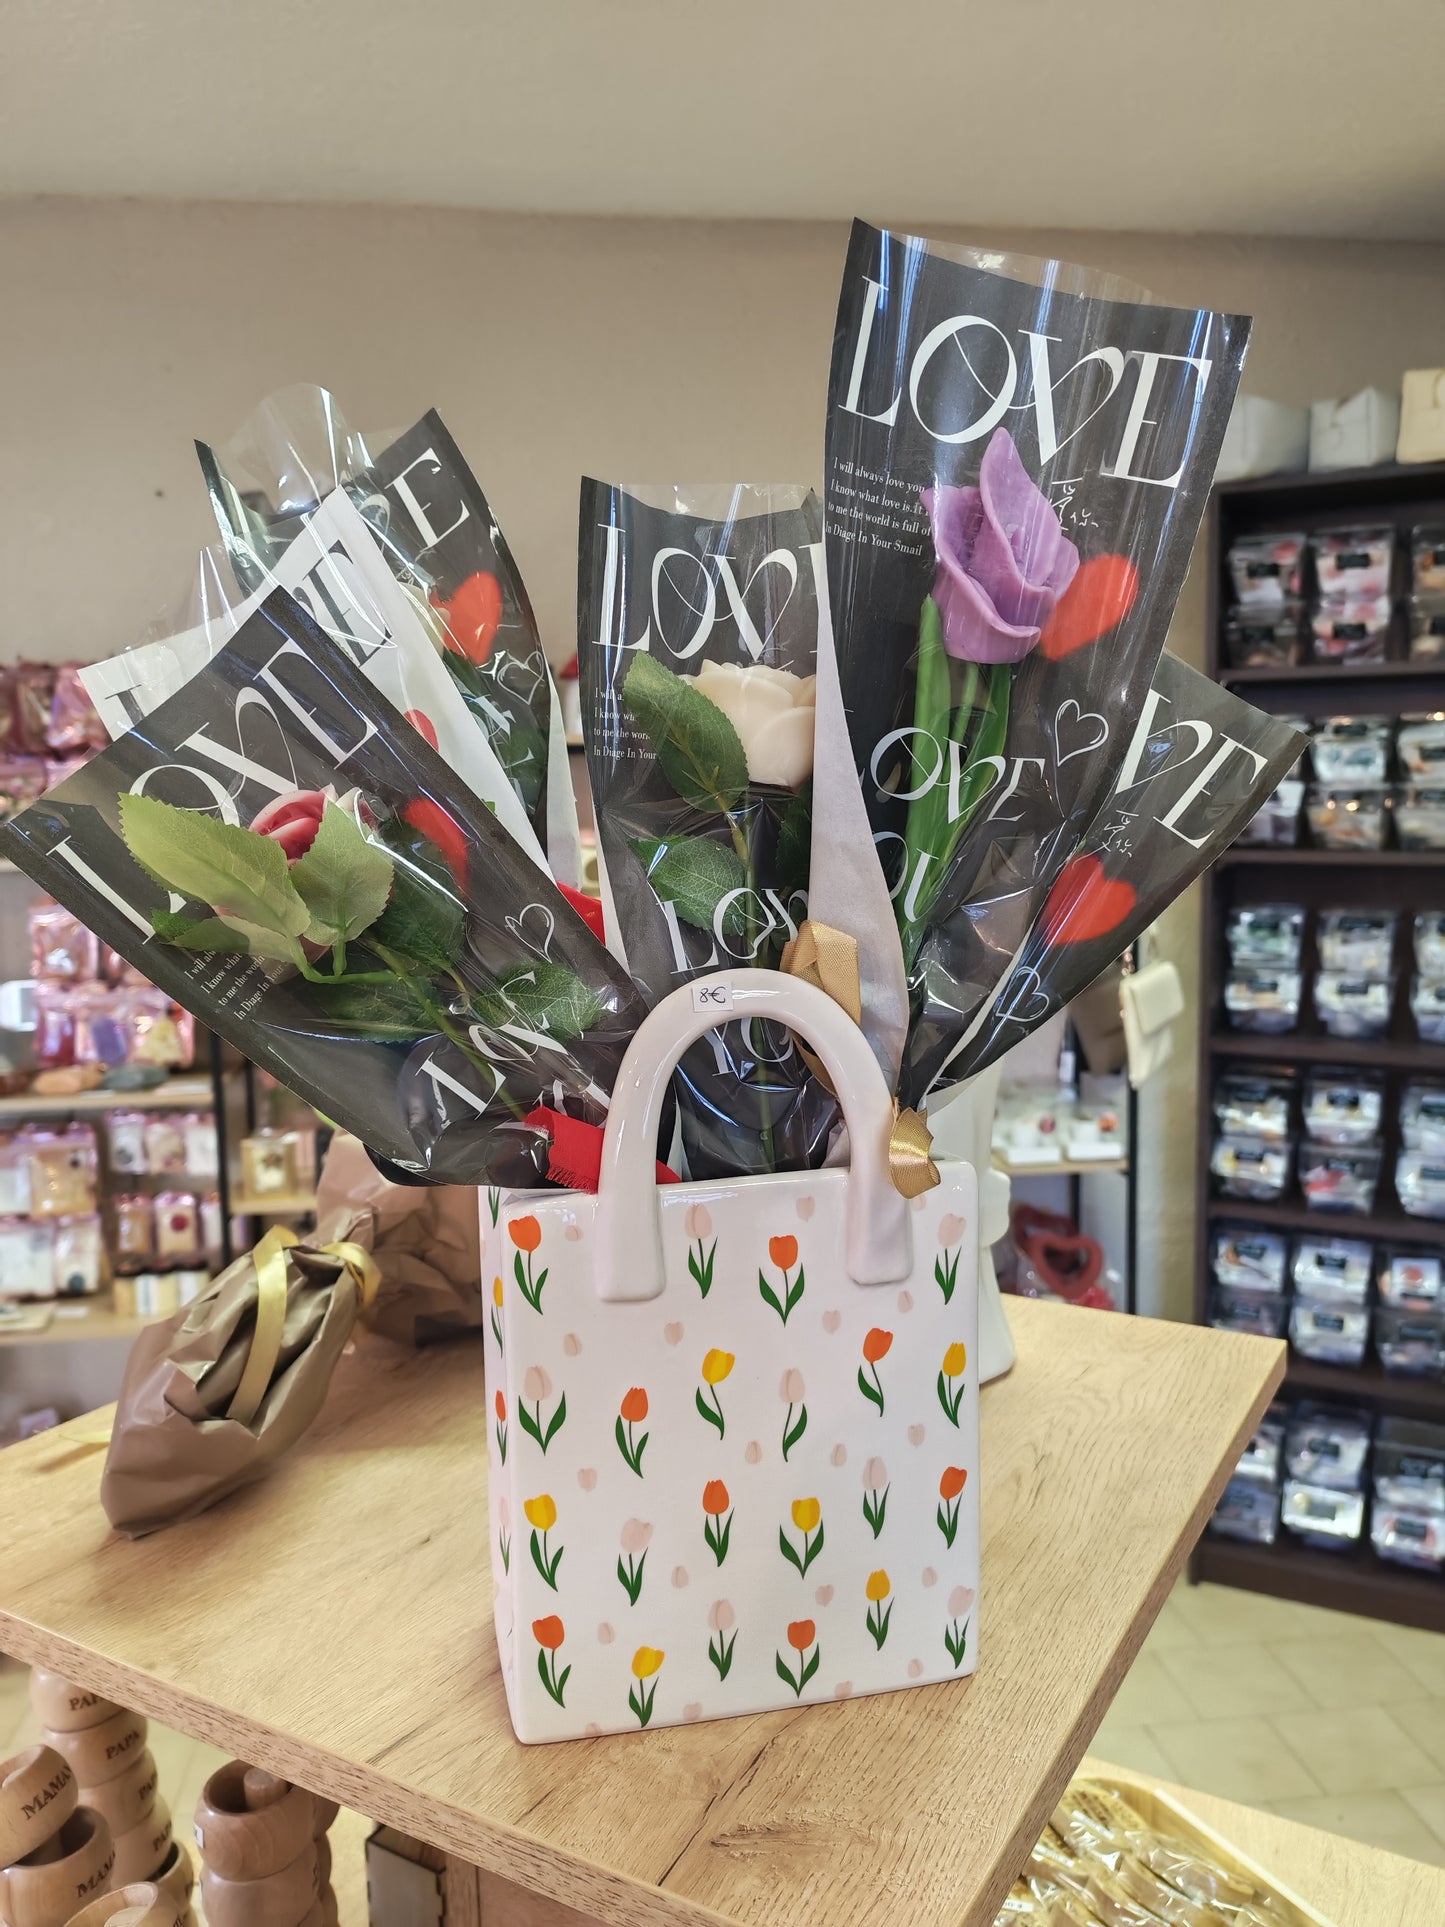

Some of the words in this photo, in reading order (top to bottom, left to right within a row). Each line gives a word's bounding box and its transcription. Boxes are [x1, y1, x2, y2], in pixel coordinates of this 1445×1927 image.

[838, 275, 1212, 488] LOVE
[834, 456, 838, 469] I
[839, 461, 854, 474] will
[855, 466, 884, 485] always
[885, 472, 905, 489] love
[830, 478, 835, 491] I
[835, 480, 857, 497] know
[858, 490, 880, 505] what
[881, 494, 900, 511] love
[828, 501, 835, 512] to
[835, 504, 848, 516] me
[849, 506, 863, 520] the
[865, 512, 891, 527] world
[891, 517, 900, 528] is
[902, 519, 920, 534] full
[833, 523, 856, 543] Diage
[858, 530, 868, 544] In
[871, 533, 893, 550] Your
[893, 539, 923, 556] Smail
[632, 732, 650, 740] wor
[627, 747, 636, 759] In
[639, 748, 657, 760] Your
[863, 726, 1046, 824] OVE
[656, 888, 808, 975] LOV
[191, 958, 206, 975] will
[205, 969, 227, 990] know
[218, 997, 228, 1007] to
[226, 986, 238, 999] me
[234, 974, 248, 987] the
[233, 1010, 247, 1021] In
[240, 990, 263, 1012] Diage
[257, 981, 270, 993] In
[700, 986, 726, 1004] 8€
